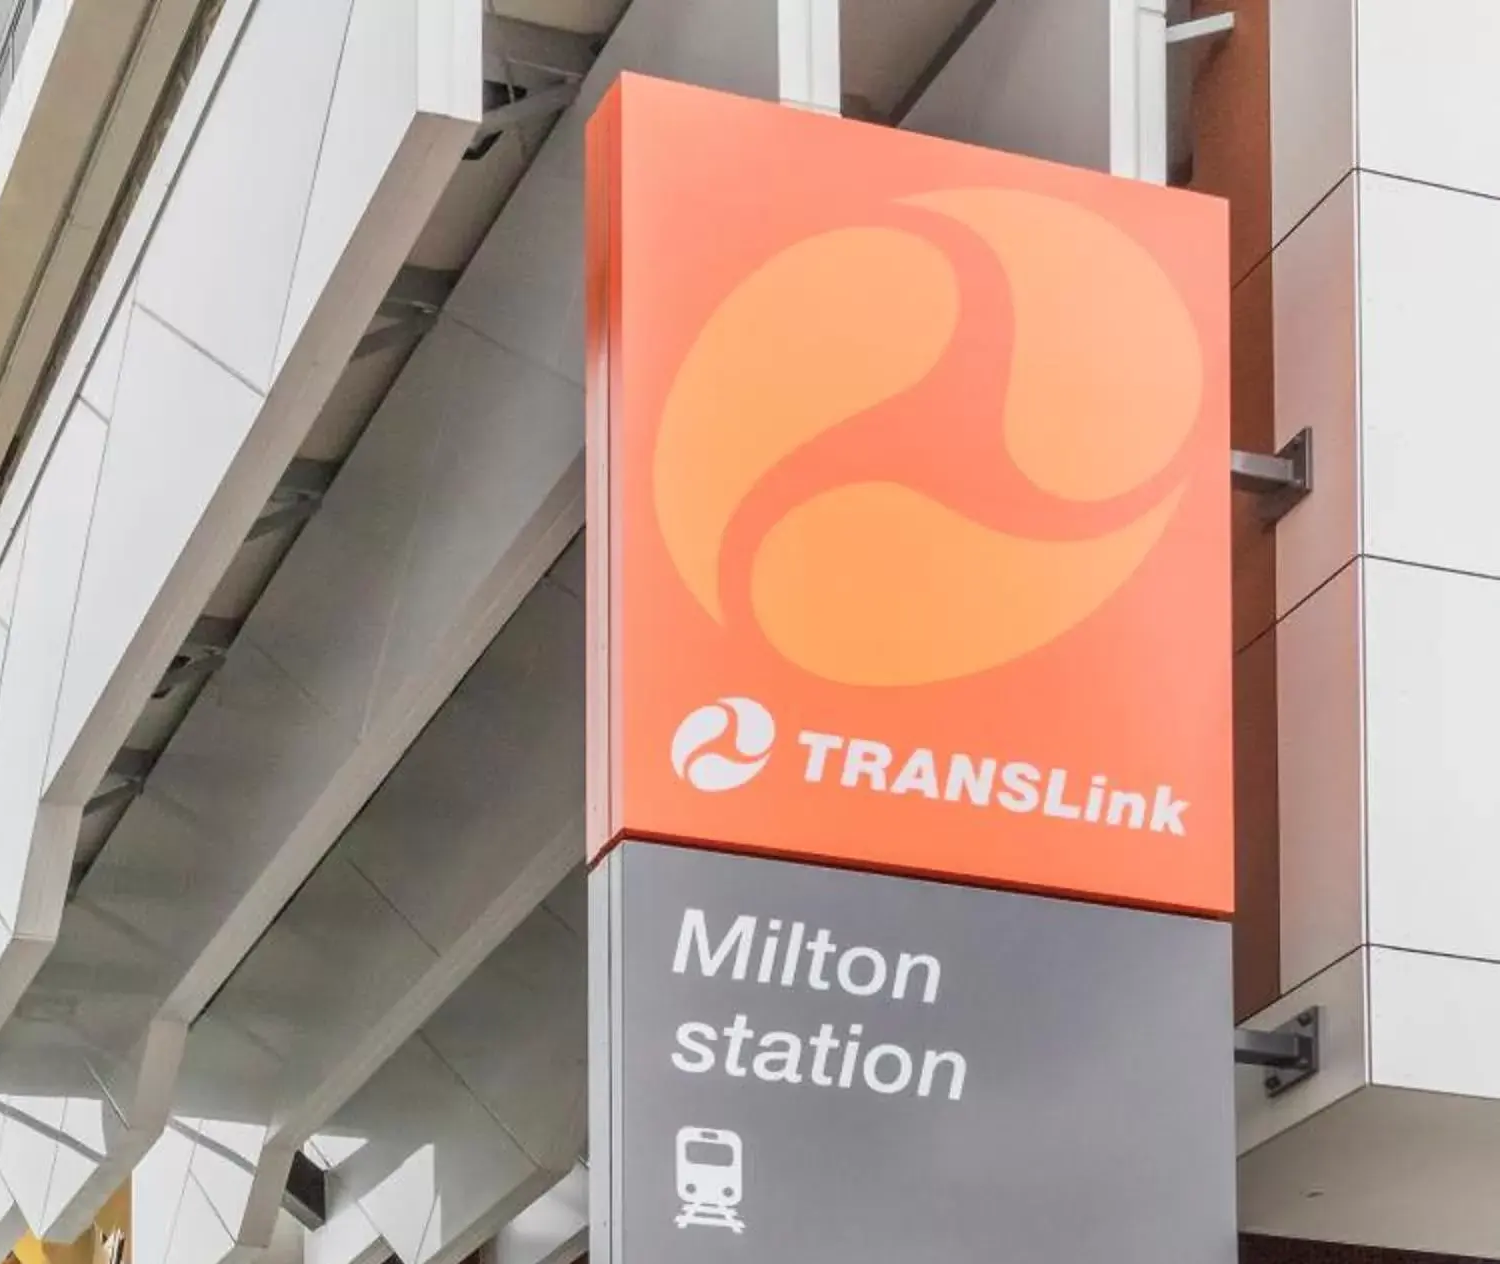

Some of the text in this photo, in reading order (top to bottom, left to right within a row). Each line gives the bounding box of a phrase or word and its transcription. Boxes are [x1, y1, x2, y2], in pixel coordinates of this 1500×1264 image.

[798, 731, 1191, 836] TRANSLink
[671, 908, 942, 1004] Milton
[671, 1014, 968, 1101] station
